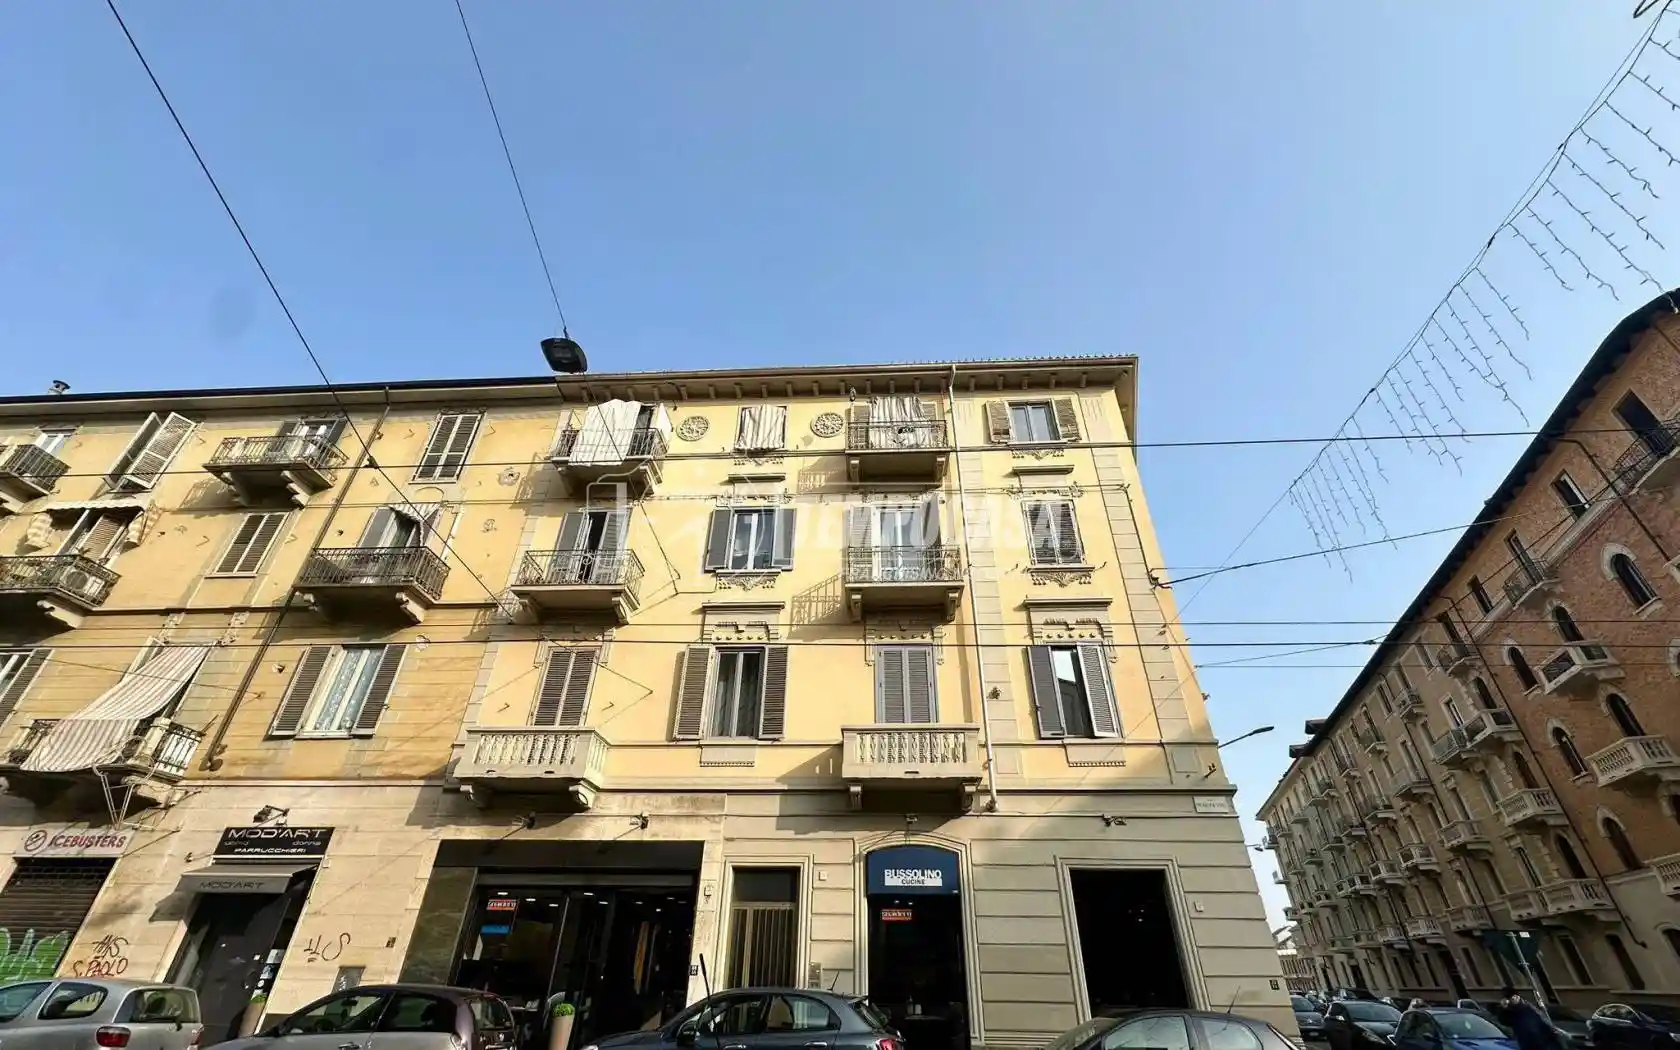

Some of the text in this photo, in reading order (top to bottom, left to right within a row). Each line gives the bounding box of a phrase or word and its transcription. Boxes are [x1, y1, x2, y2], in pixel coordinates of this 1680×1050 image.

[227, 828, 328, 839] MOD'ART
[47, 834, 127, 849] ICEBUSTERS
[884, 868, 942, 879] BUSSOLINO
